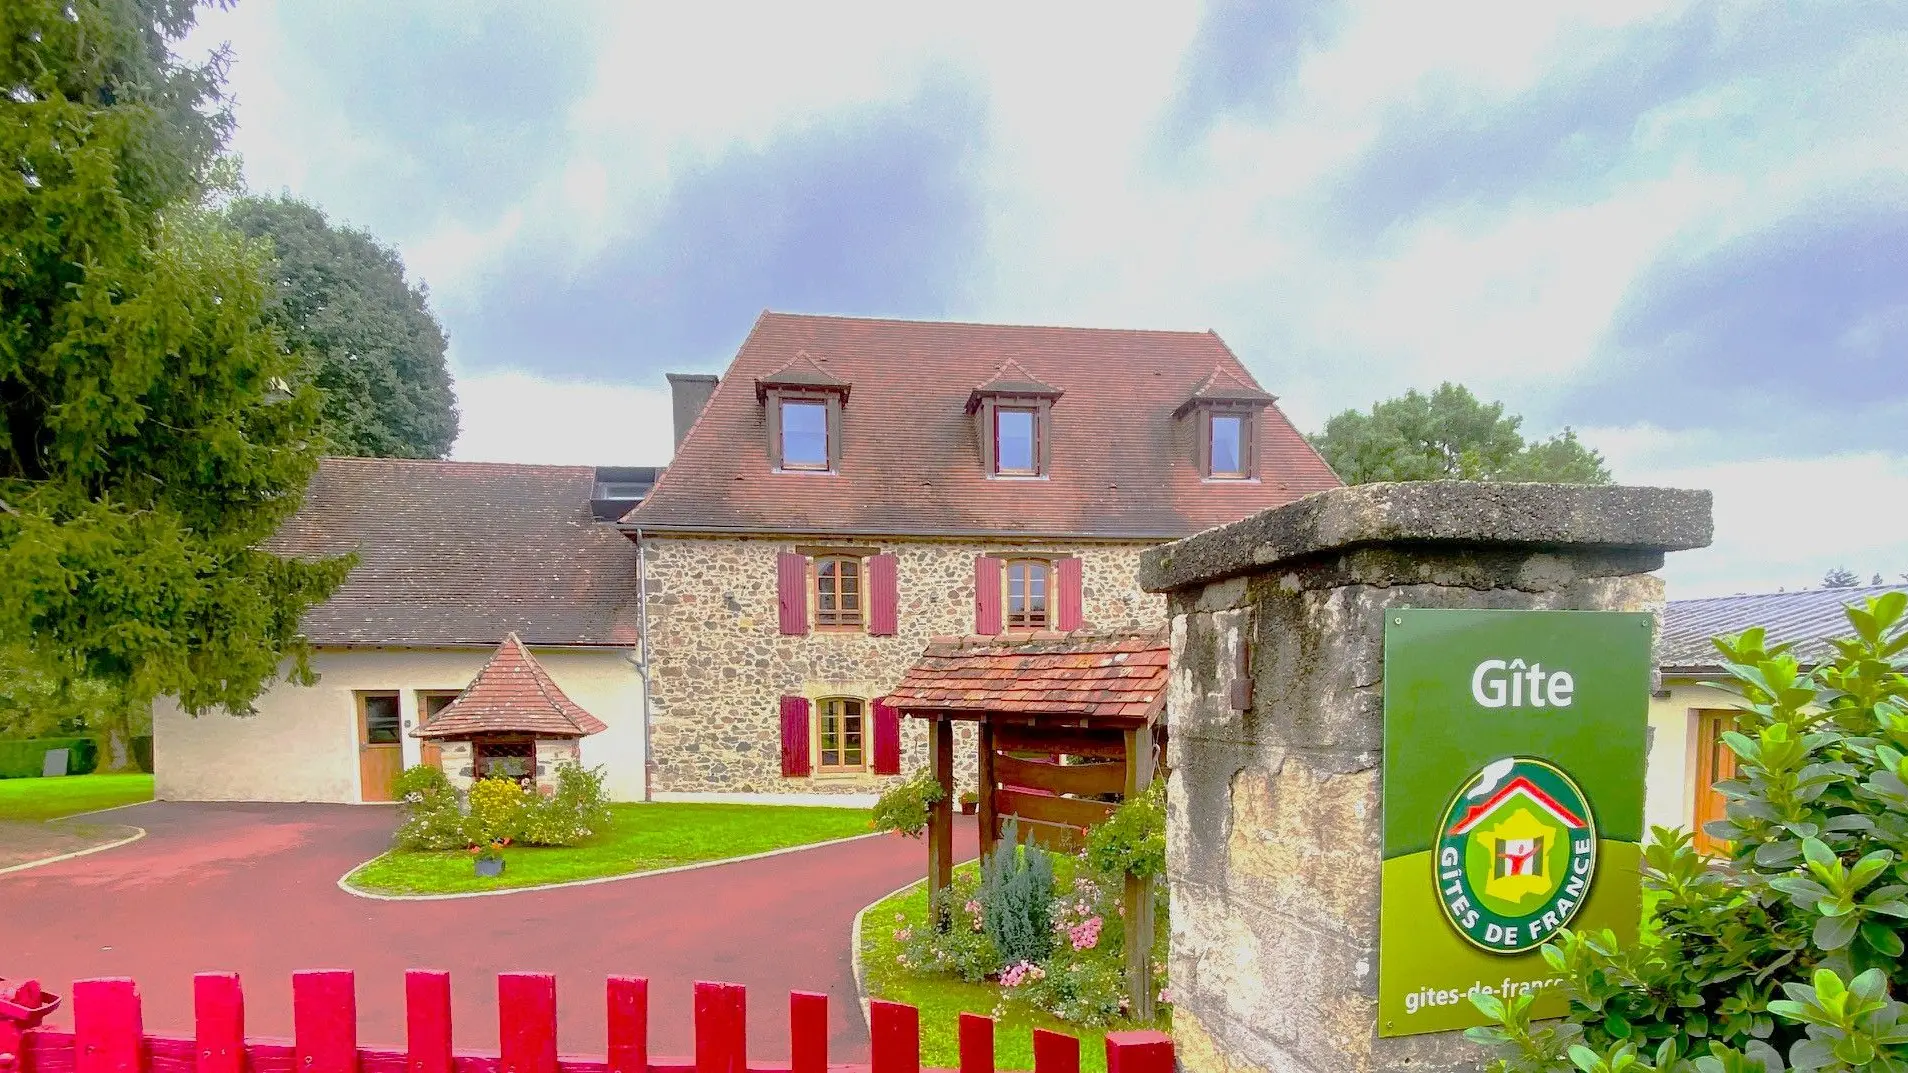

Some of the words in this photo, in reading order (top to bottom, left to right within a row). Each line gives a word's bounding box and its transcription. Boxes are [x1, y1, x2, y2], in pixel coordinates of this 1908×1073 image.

[1472, 658, 1574, 708] Gîte
[1441, 846, 1480, 929] GÎTES
[1484, 923, 1518, 946] DE
[1529, 838, 1591, 940] FRANCE
